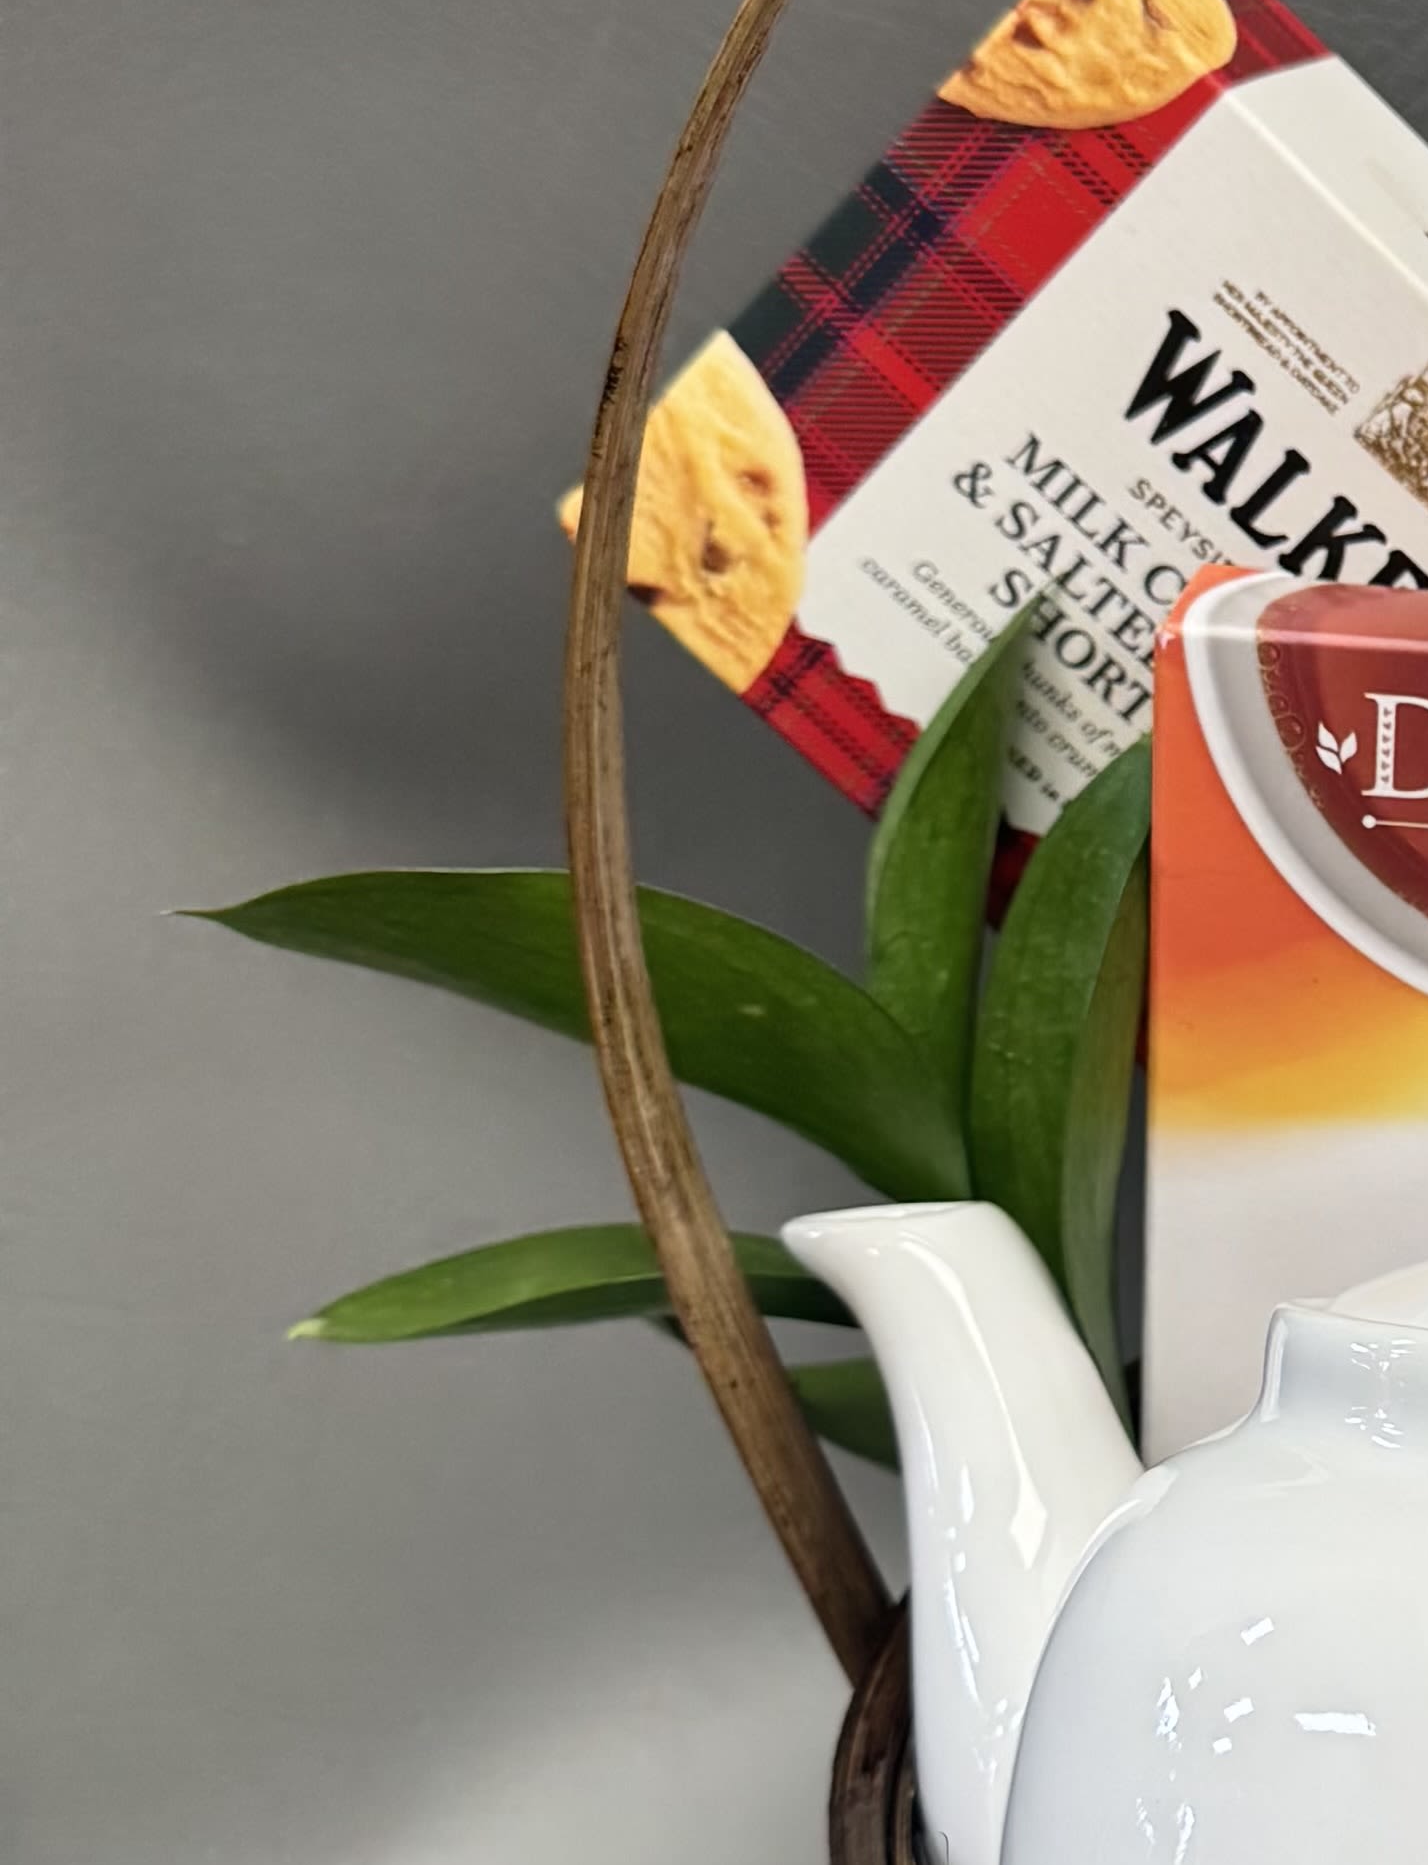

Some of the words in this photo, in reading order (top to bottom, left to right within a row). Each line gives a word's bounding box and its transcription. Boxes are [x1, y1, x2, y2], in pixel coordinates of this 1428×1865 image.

[952, 461, 996, 510] &
[994, 498, 1155, 673] SALTE
[1003, 431, 1150, 574] MILK
[1129, 478, 1236, 566] SPEYSI
[912, 559, 993, 641] Generou
[988, 568, 1153, 725] SHORT
